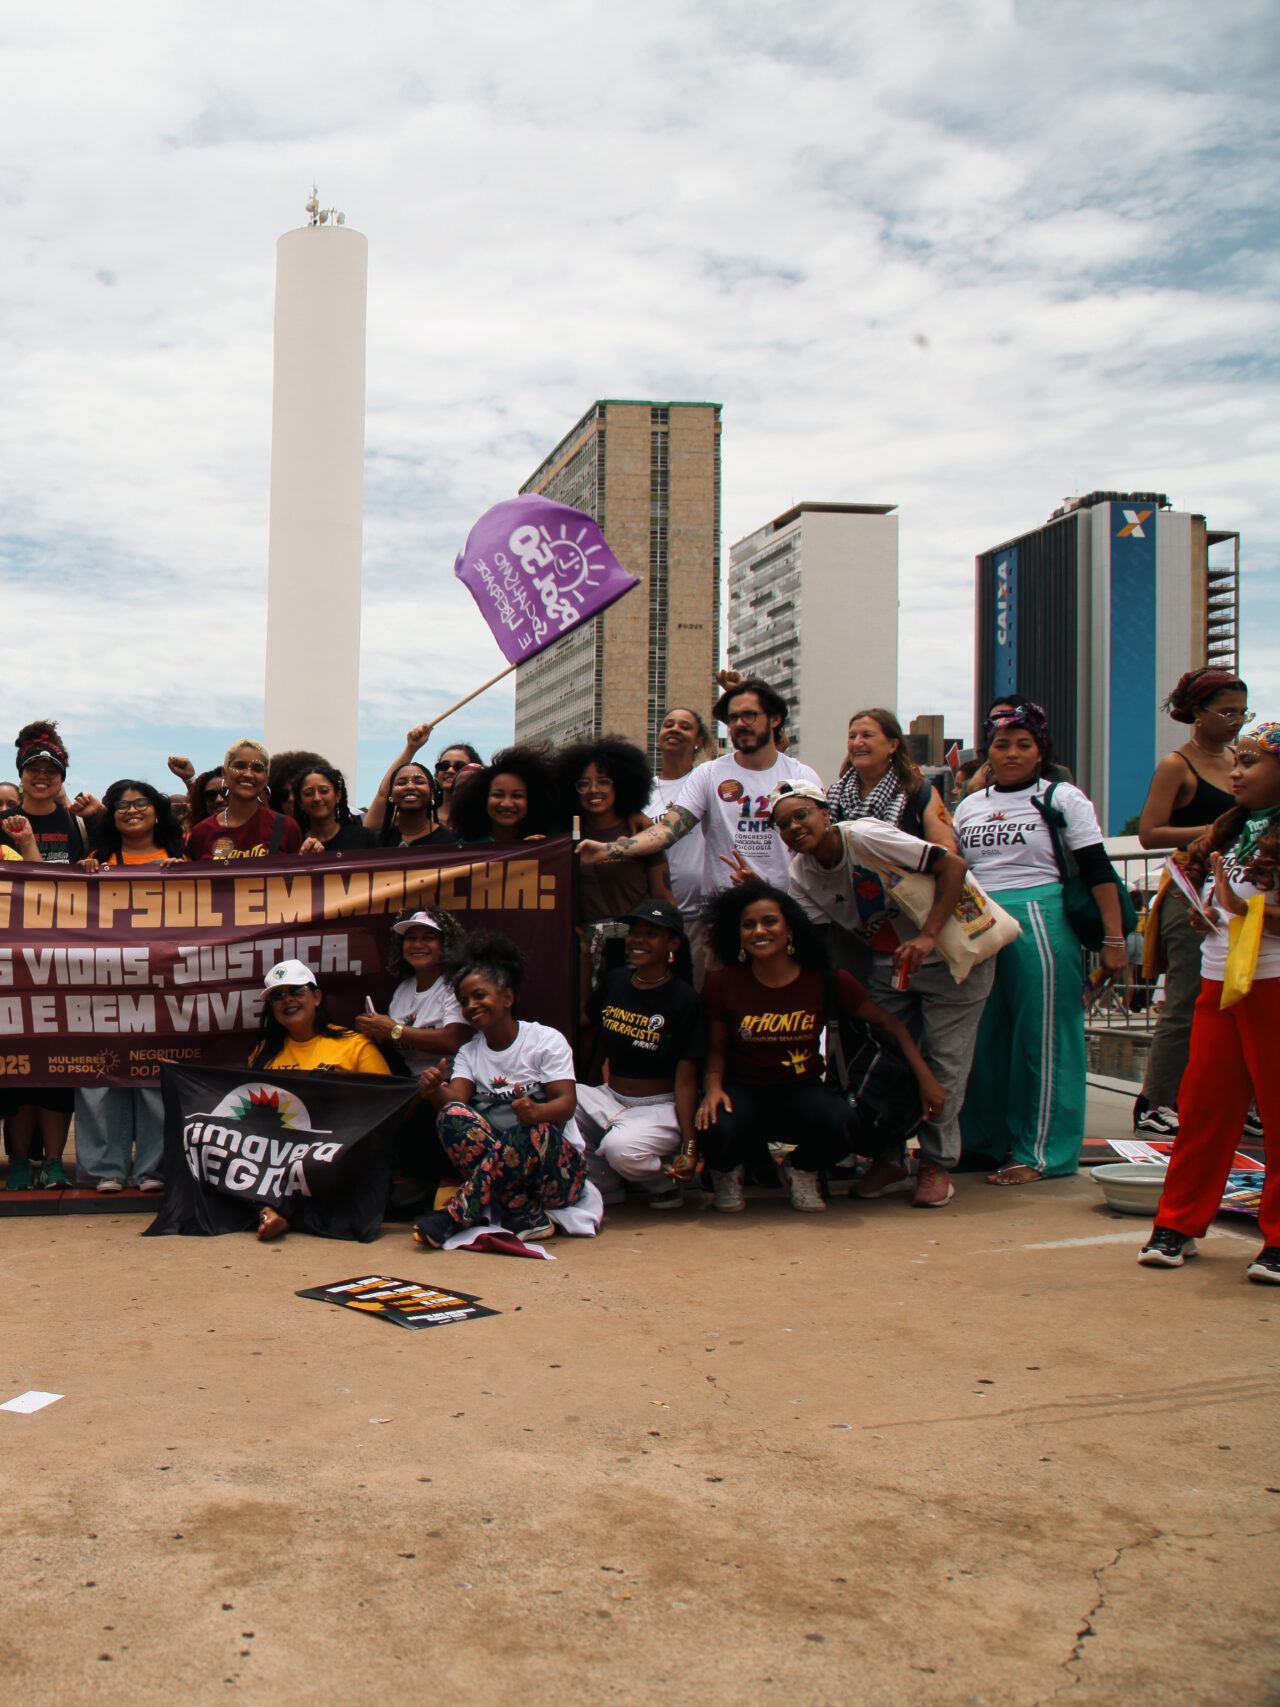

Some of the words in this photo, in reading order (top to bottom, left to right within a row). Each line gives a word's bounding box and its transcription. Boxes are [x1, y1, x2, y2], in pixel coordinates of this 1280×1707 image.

[997, 560, 1008, 646] CAIXA
[961, 832, 1027, 849] NEGRA
[23, 881, 88, 930] DO
[99, 880, 223, 929] PSOL
[234, 875, 312, 927] EM
[323, 859, 556, 920] MARCHA:
[23, 946, 165, 988] VIDAS,
[32, 996, 59, 1033] E
[67, 995, 156, 1033] BEM
[163, 988, 268, 1033] VIVE
[48, 1056, 106, 1065] MULHERES
[48, 1064, 64, 1074] DO
[67, 1064, 96, 1074] PSOL
[129, 1048, 201, 1062] NEGRITUDE
[130, 1065, 149, 1077] DO
[184, 1122, 344, 1166] rimavera
